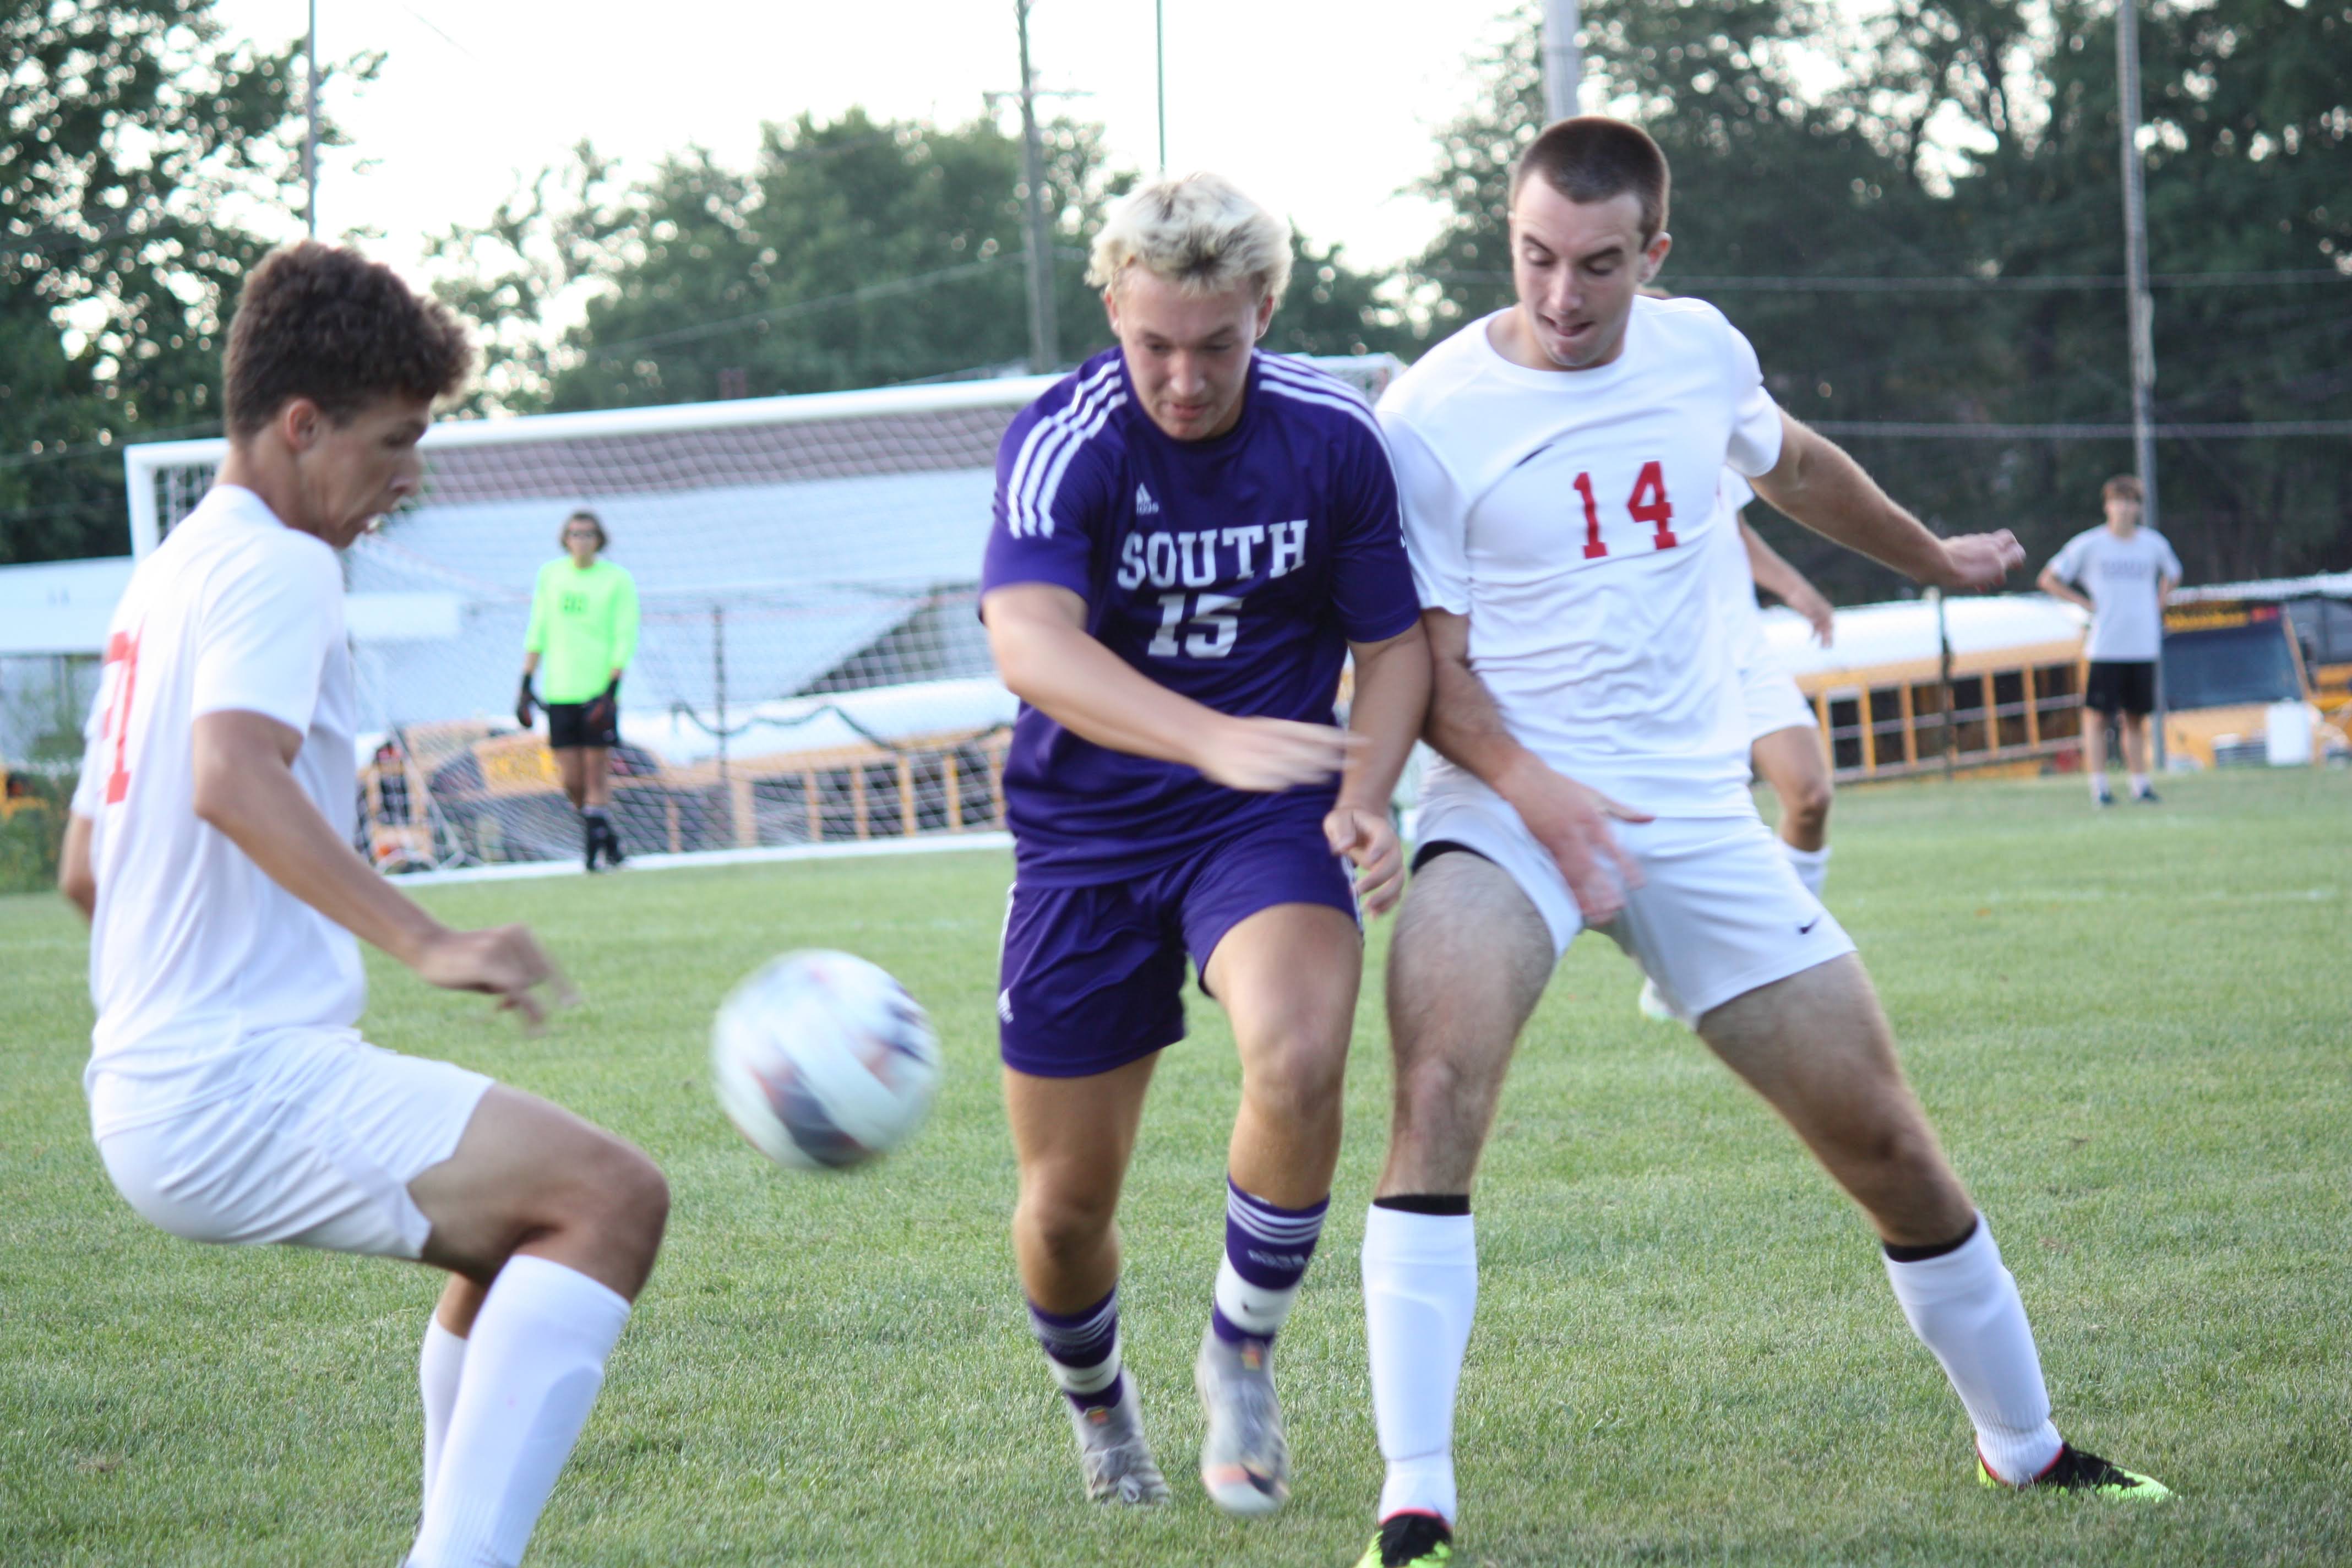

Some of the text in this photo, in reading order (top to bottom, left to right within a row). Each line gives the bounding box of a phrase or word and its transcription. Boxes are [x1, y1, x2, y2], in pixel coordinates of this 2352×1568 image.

[1573, 460, 1677, 559] 14
[1117, 519, 1308, 590] SOUTH
[1147, 593, 1245, 658] 15
